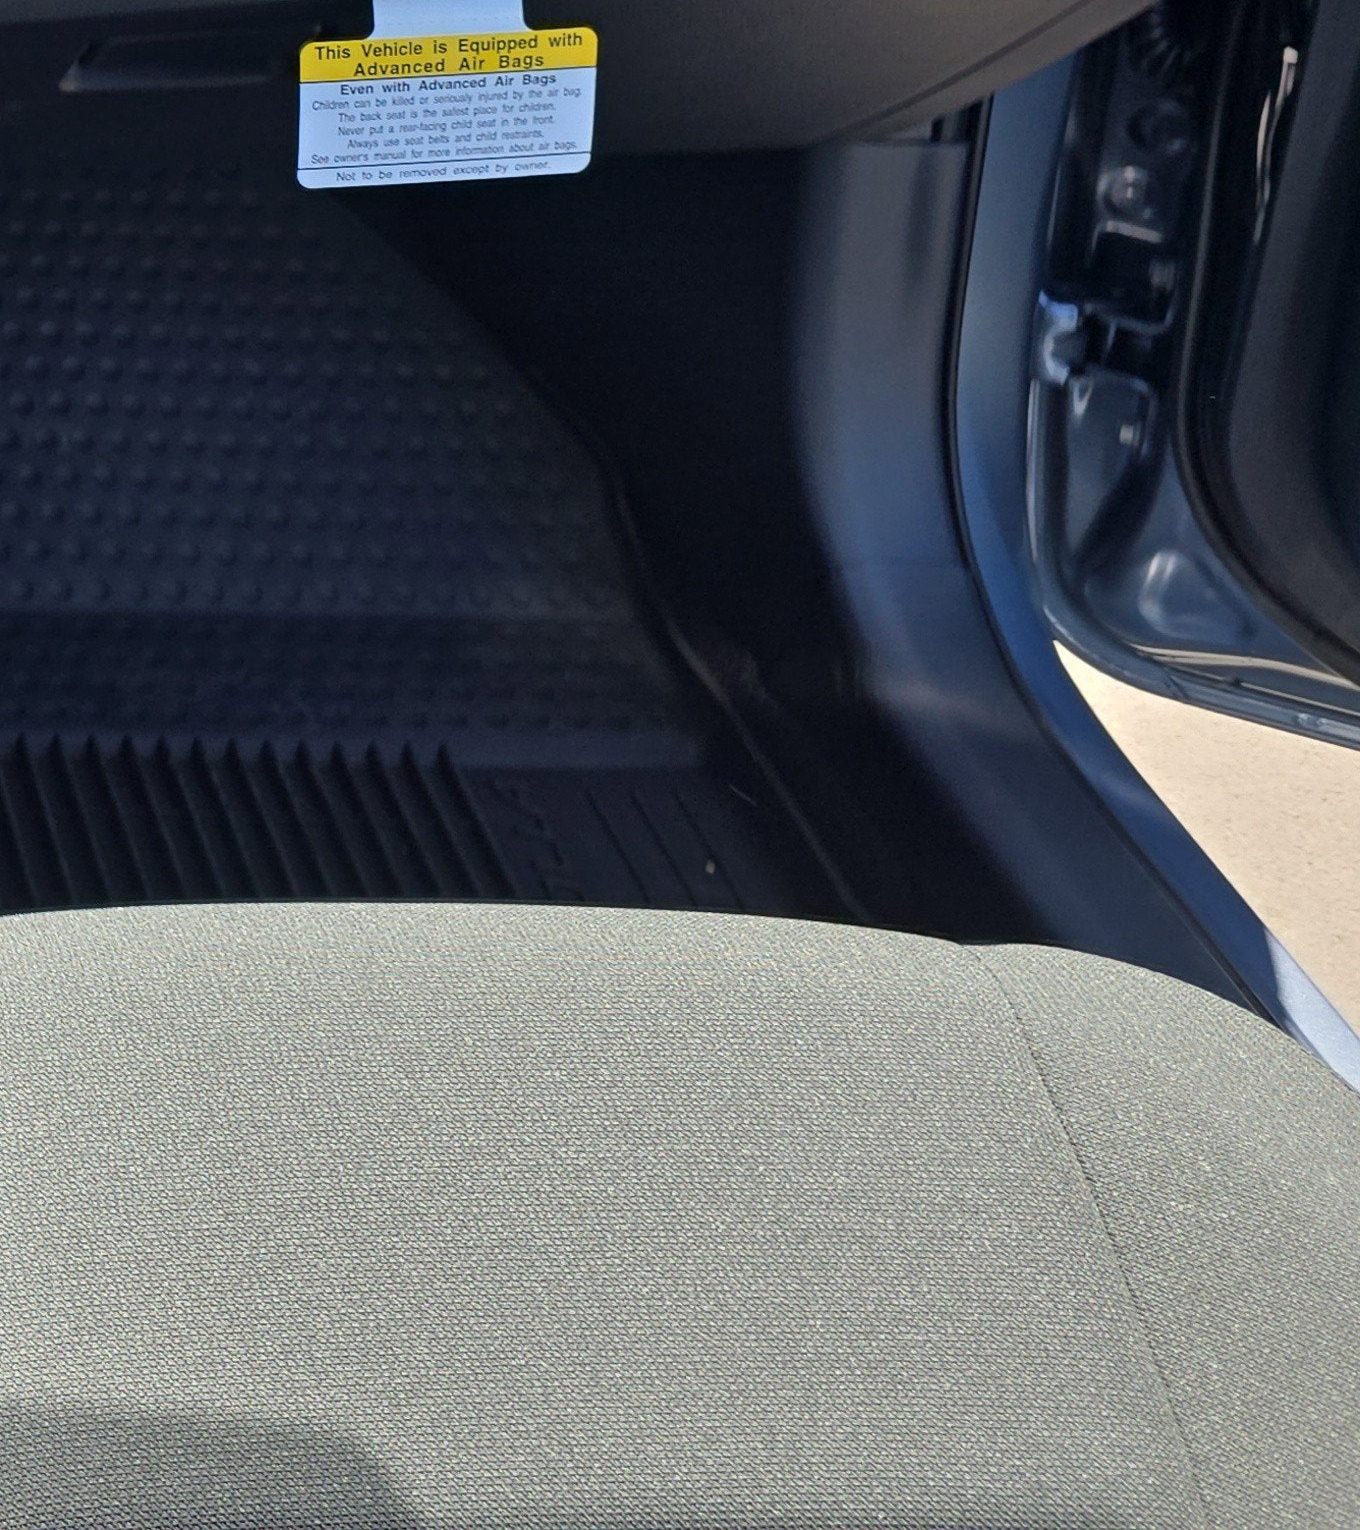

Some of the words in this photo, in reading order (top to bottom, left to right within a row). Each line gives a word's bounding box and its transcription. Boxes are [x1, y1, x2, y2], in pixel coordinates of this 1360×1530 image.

[314, 45, 351, 60] This
[361, 42, 423, 58] Vehicle
[434, 43, 447, 54] is
[458, 35, 538, 55] Equipped
[548, 33, 582, 47] with
[353, 59, 445, 77] Advanced
[459, 58, 485, 71] Air
[499, 55, 544, 72] Bags
[340, 84, 374, 95] Even
[382, 81, 410, 93] with
[418, 77, 486, 91] Advanced
[494, 75, 514, 86] Air
[522, 74, 556, 86] Bags
[336, 171, 356, 182] Not
[361, 171, 373, 180] to
[378, 170, 393, 180] be
[399, 166, 447, 178] removed
[452, 164, 490, 175] except
[495, 163, 509, 174] by
